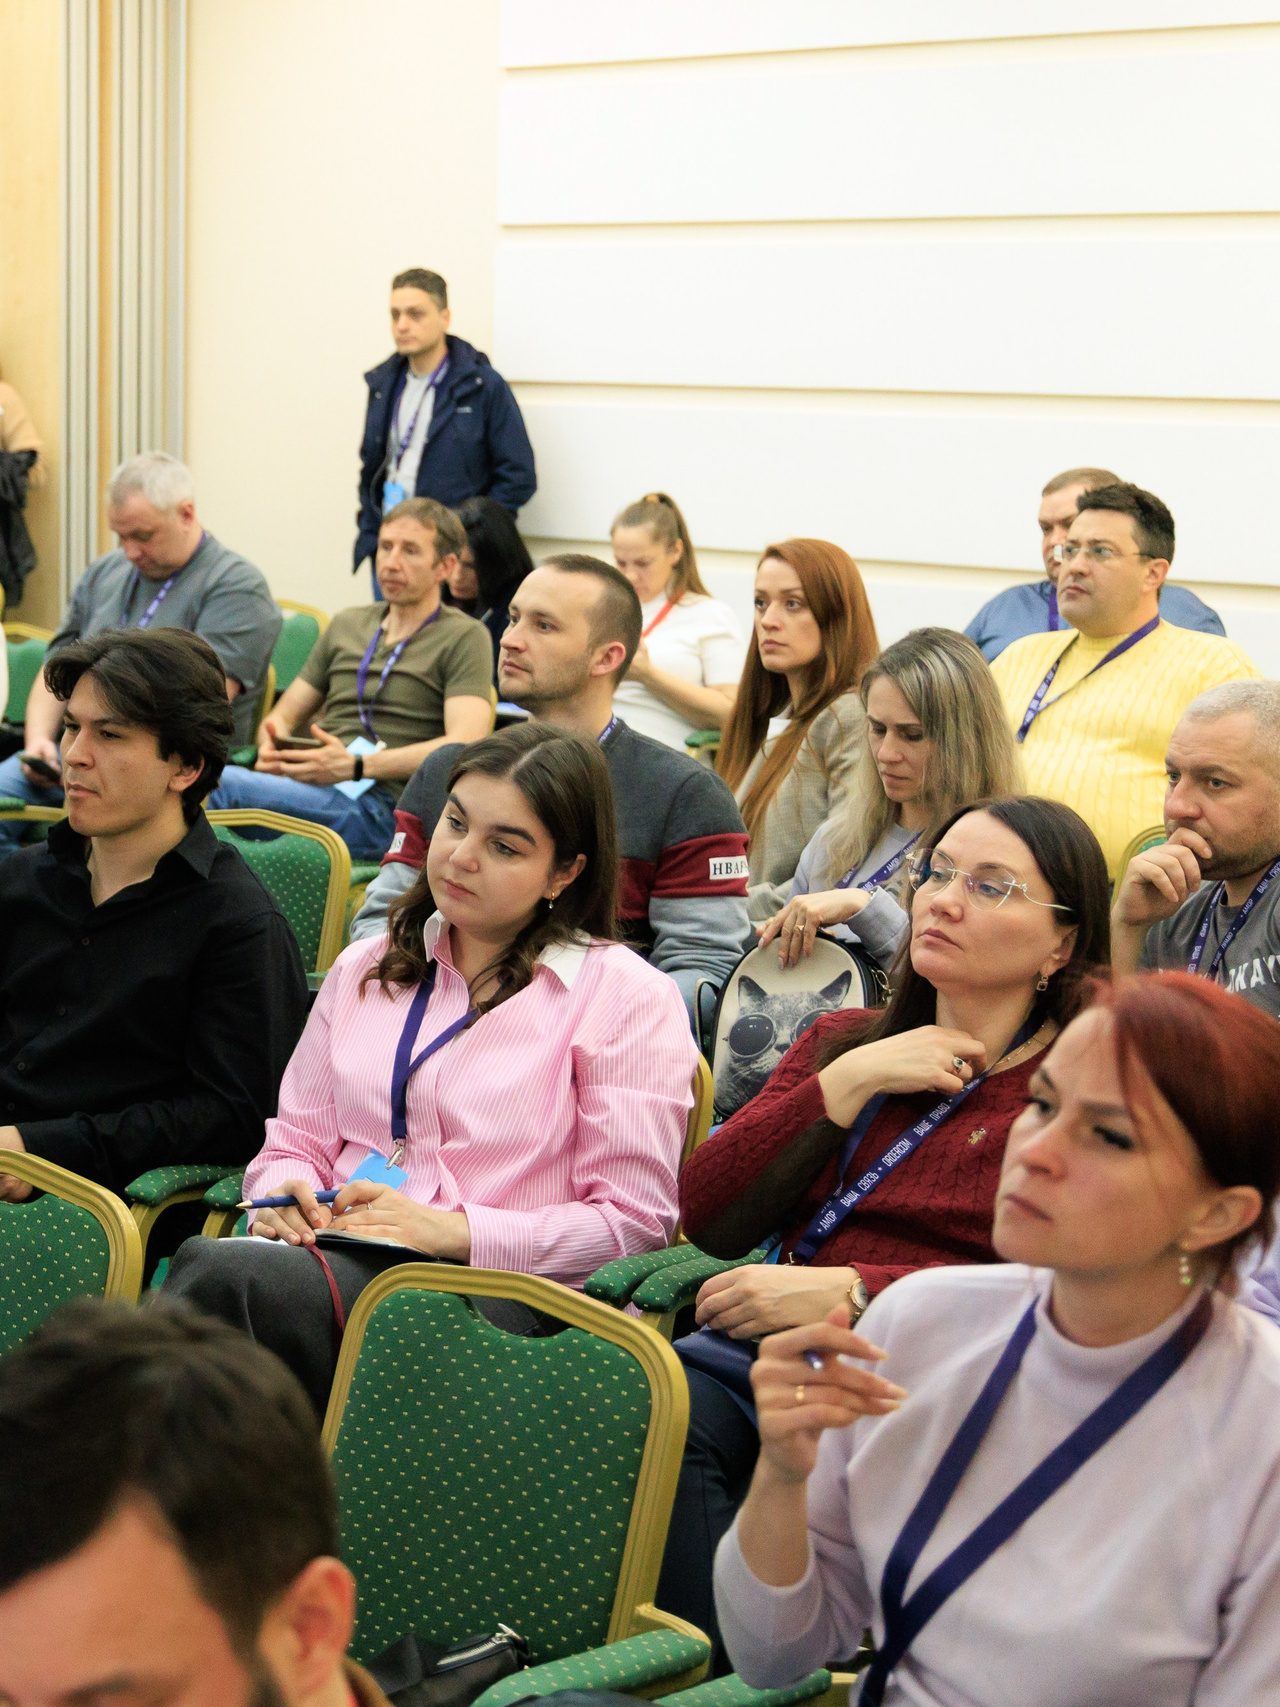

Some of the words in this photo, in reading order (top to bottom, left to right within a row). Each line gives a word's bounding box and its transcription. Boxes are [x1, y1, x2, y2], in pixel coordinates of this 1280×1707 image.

[881, 1138, 913, 1167] ORDERCOM
[912, 1119, 933, 1137] ВАШЕ
[929, 1102, 951, 1121] ПРАВО
[819, 1210, 838, 1231] АМОР
[840, 1190, 861, 1208] ВАША
[857, 1171, 880, 1192] СВЯЗЬ
